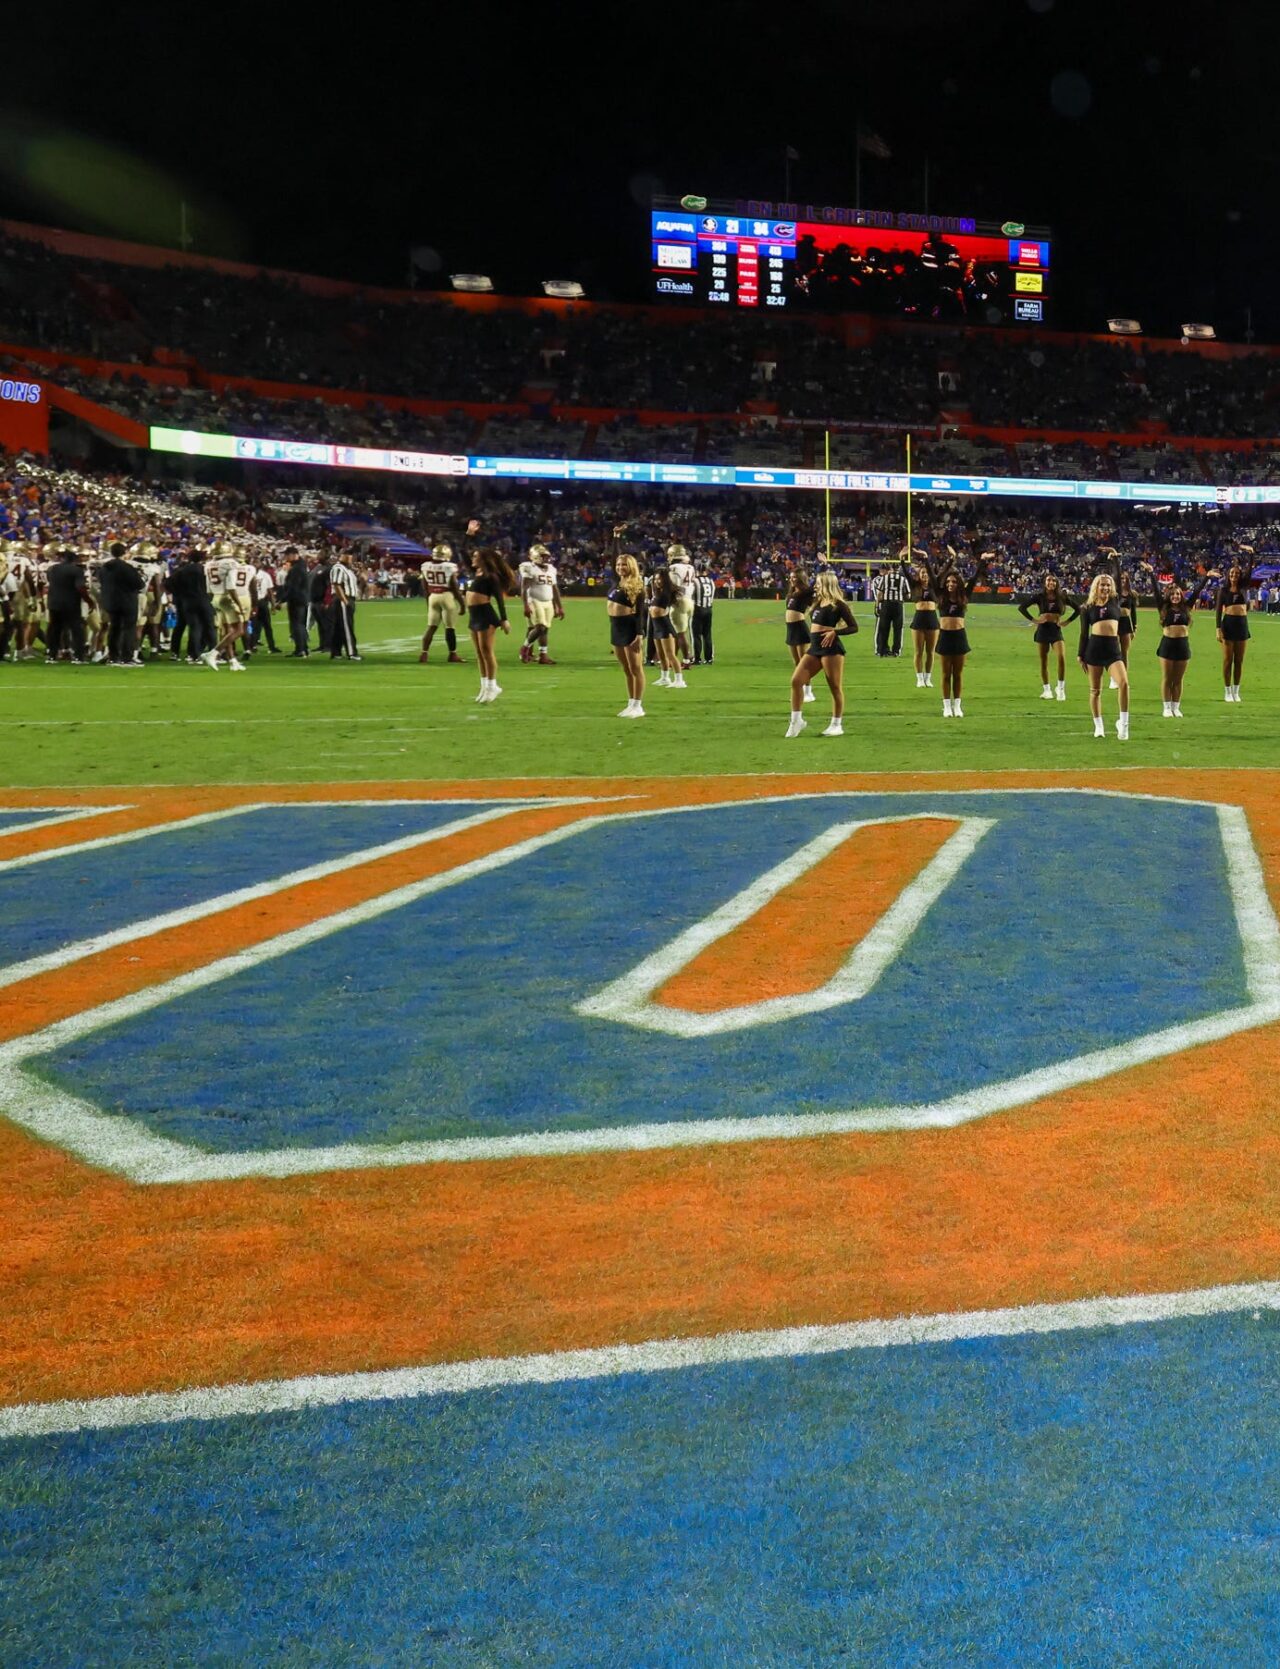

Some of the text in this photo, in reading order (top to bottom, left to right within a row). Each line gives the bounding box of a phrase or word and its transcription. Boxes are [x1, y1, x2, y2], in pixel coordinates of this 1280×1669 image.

[236, 571, 247, 587] 9
[426, 571, 446, 585] 90
[891, 579, 898, 591] L
[703, 583, 712, 597] B
